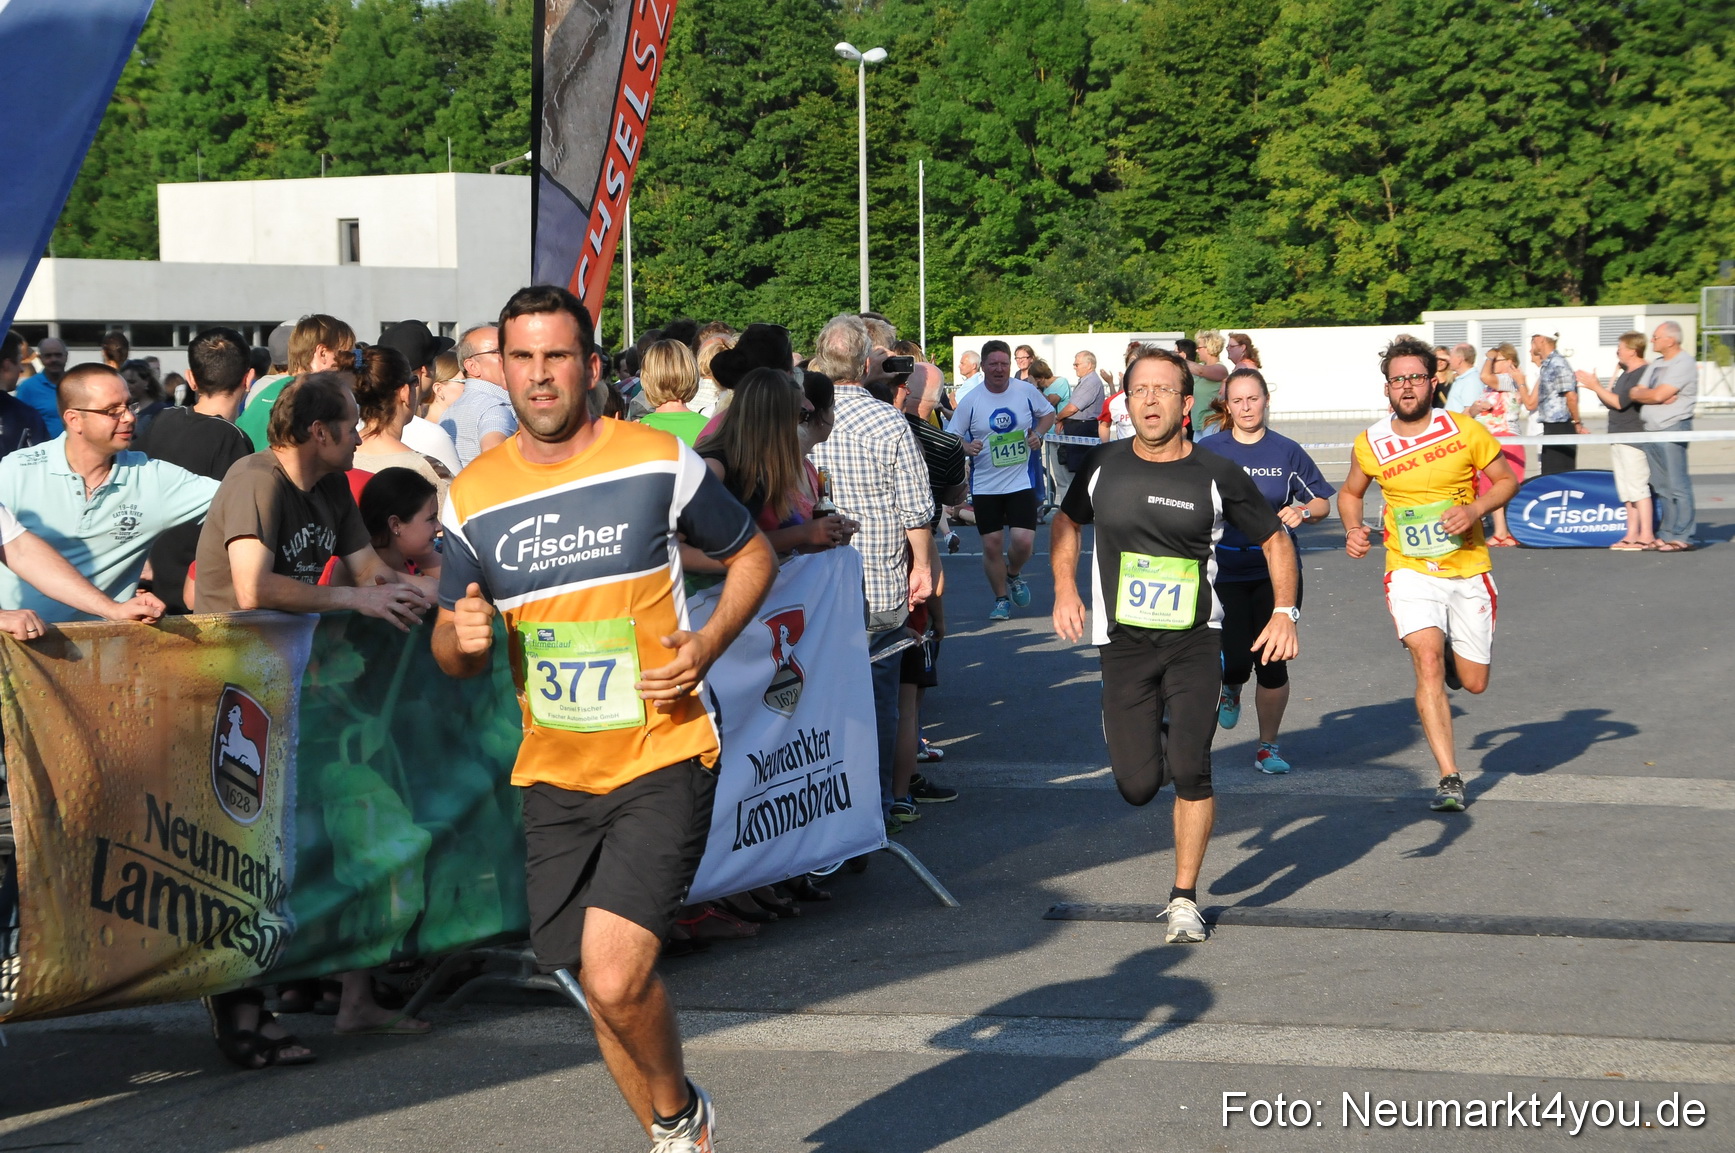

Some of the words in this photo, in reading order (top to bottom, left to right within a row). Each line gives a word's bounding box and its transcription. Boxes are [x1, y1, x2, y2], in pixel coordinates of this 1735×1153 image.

[992, 441, 1026, 459] 1415
[1382, 458, 1420, 481] MAX
[1423, 440, 1467, 463] BÖGL
[1251, 467, 1283, 477] POLES
[1154, 496, 1195, 511] PFLEIDERER
[518, 523, 629, 563] Fischer
[1405, 521, 1450, 547] 819
[528, 544, 622, 573] AUTOMOBILE
[1128, 580, 1182, 611] 971
[536, 658, 617, 703] 377
[560, 704, 577, 712] Daniel
[578, 704, 603, 712] Fischer
[774, 688, 799, 709] 1628
[548, 712, 566, 720] Fischer
[567, 714, 598, 722] Automobile
[600, 712, 620, 720] GmbH
[746, 727, 831, 787] Neumarkter
[225, 785, 250, 813] 1628
[732, 765, 853, 852] Lammsbräu
